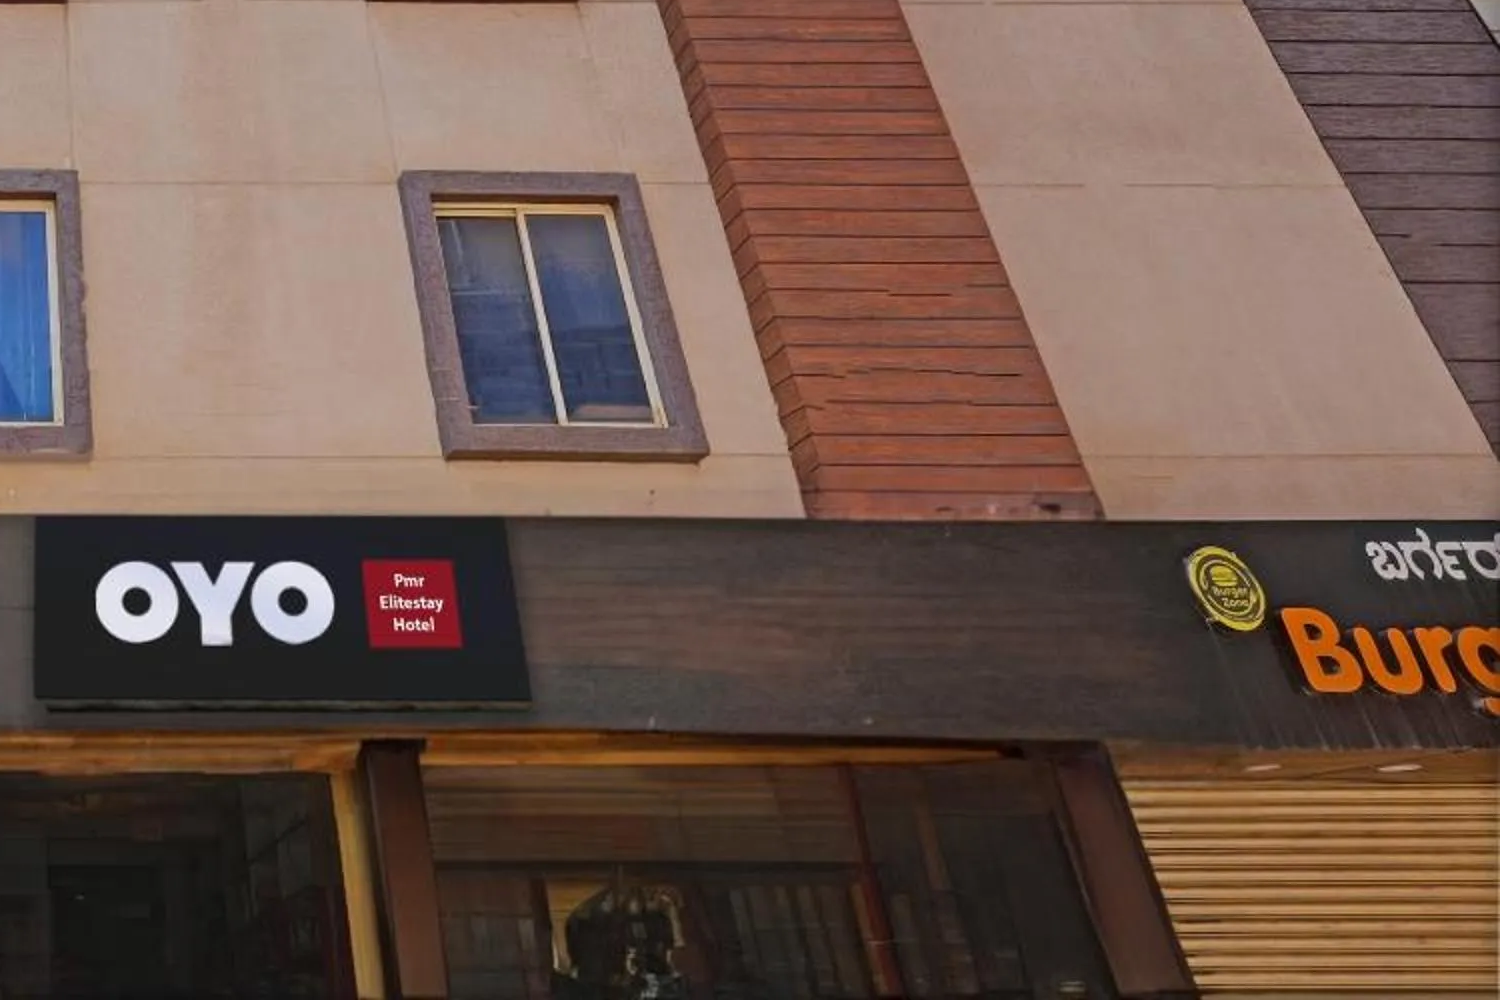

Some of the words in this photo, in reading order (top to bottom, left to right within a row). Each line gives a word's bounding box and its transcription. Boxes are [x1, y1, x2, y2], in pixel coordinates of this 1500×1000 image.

[393, 573, 425, 588] Pmr
[95, 560, 335, 646] OYO
[379, 594, 444, 613] Elitestay
[393, 615, 435, 632] Hotel
